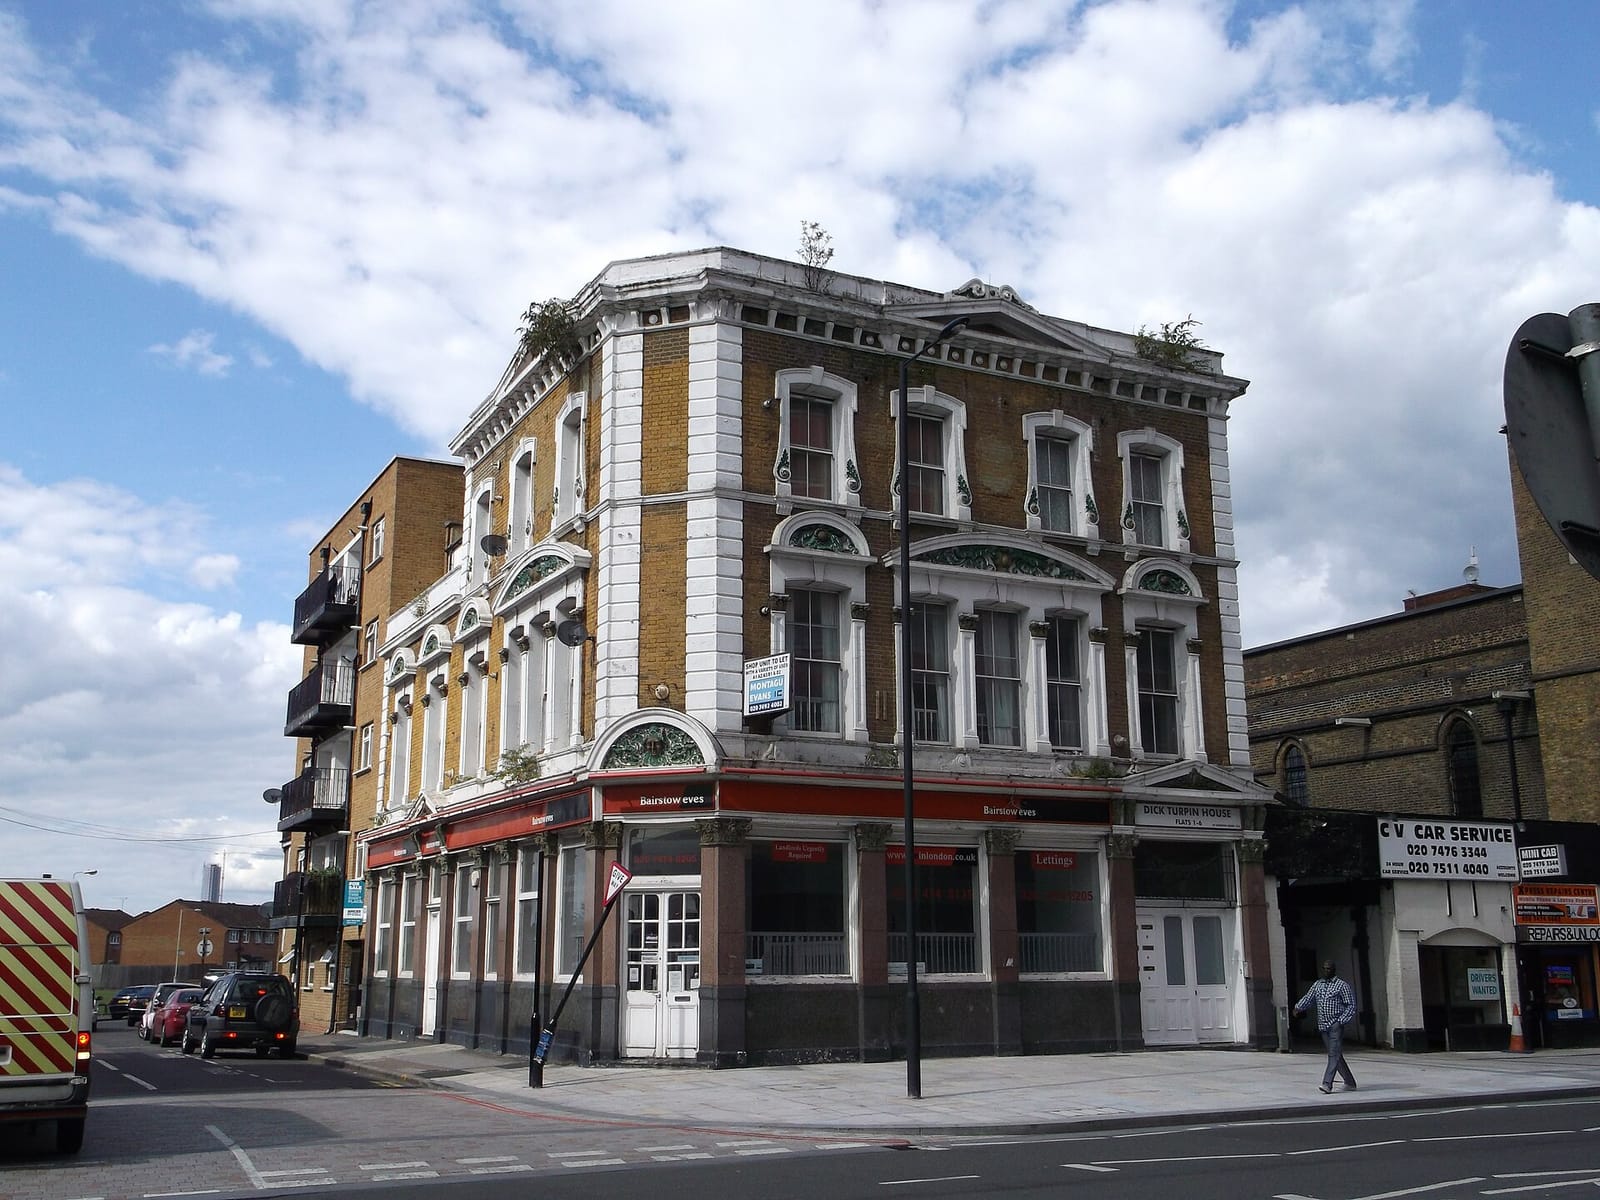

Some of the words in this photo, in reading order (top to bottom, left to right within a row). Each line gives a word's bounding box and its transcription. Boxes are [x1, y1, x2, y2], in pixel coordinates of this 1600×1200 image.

[750, 679, 783, 690] MONTAGU
[750, 692, 771, 702] EVANS
[640, 796, 680, 806] Bairstow
[984, 806, 1017, 815] Bairstow
[1144, 805, 1164, 815] DICK
[1167, 807, 1198, 816] TURPIN
[1202, 808, 1231, 818] HOUSE
[1380, 823, 1390, 838] C
[1394, 824, 1404, 838] V
[1414, 825, 1446, 840] CAR
[1450, 827, 1512, 842] SERVICE
[1407, 844, 1427, 856] 020
[1430, 846, 1458, 857] 7476
[1461, 847, 1488, 858] 3344
[1522, 849, 1540, 859] MINI
[1541, 848, 1556, 857] CAB
[1036, 854, 1072, 867] Lettings
[1408, 862, 1429, 873] 020
[1432, 863, 1459, 874] 7511
[1463, 864, 1489, 874] 4040
[613, 870, 624, 883] GIVE
[1471, 974, 1496, 982] DRIVERS
[1472, 986, 1496, 994] WANTED
